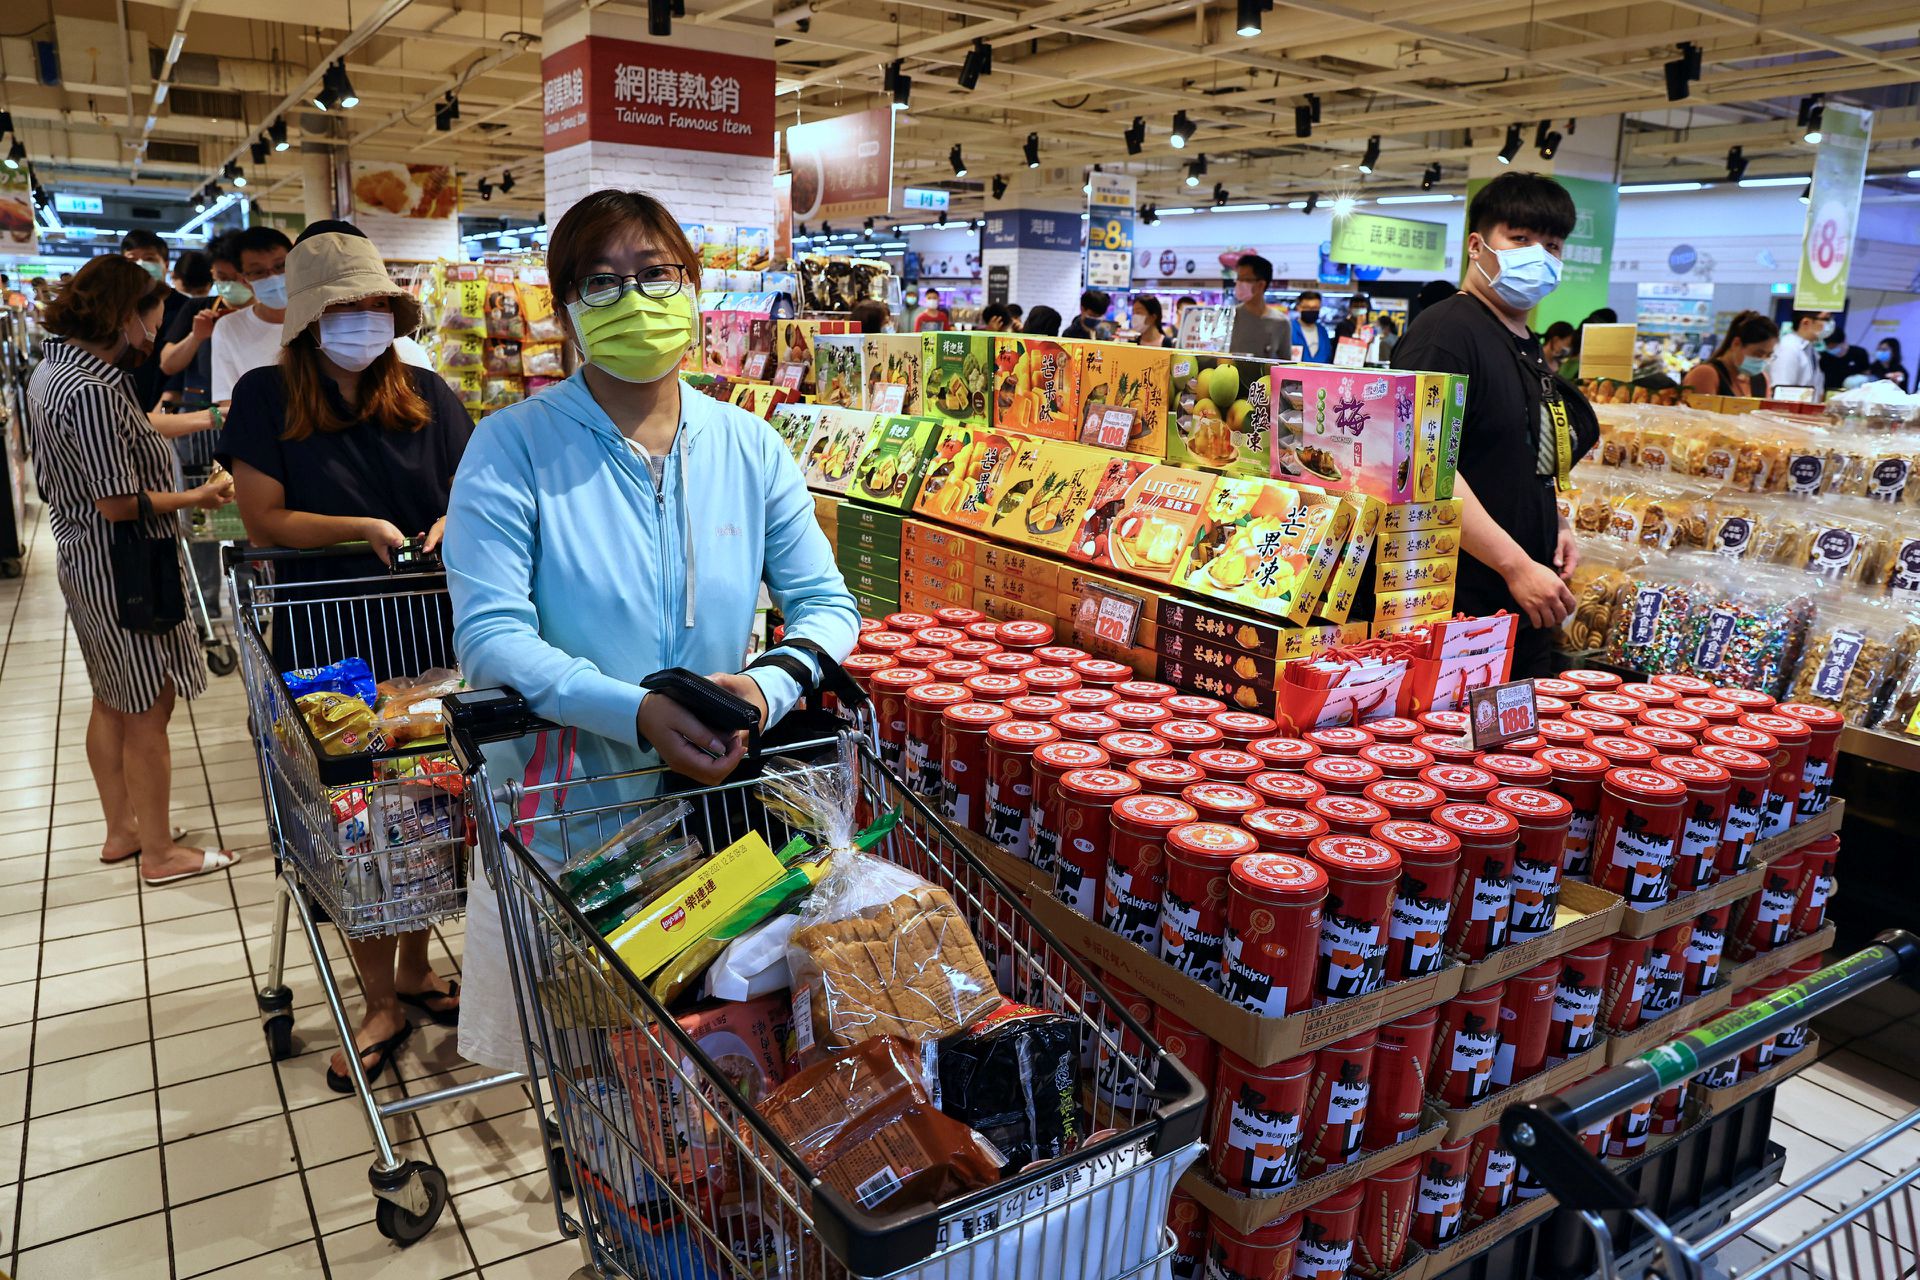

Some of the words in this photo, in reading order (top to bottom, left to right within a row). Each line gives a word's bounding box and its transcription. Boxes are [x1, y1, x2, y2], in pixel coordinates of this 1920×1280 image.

[614, 62, 741, 115] 網購熱銷
[615, 106, 664, 127] Taiwan
[669, 113, 718, 132] Famous
[722, 118, 753, 135] Item
[1105, 220, 1121, 250] 8
[1039, 353, 1057, 424] 芒果酥
[1333, 396, 1371, 437] 梅
[1101, 426, 1123, 446] 108
[961, 448, 998, 513] 芒果酥
[1143, 479, 1200, 502] LITCHI
[1255, 504, 1309, 588] 芒果凍
[1099, 617, 1123, 640] 120
[1500, 706, 1530, 733] 188
[1264, 944, 1286, 957] 牛奶
